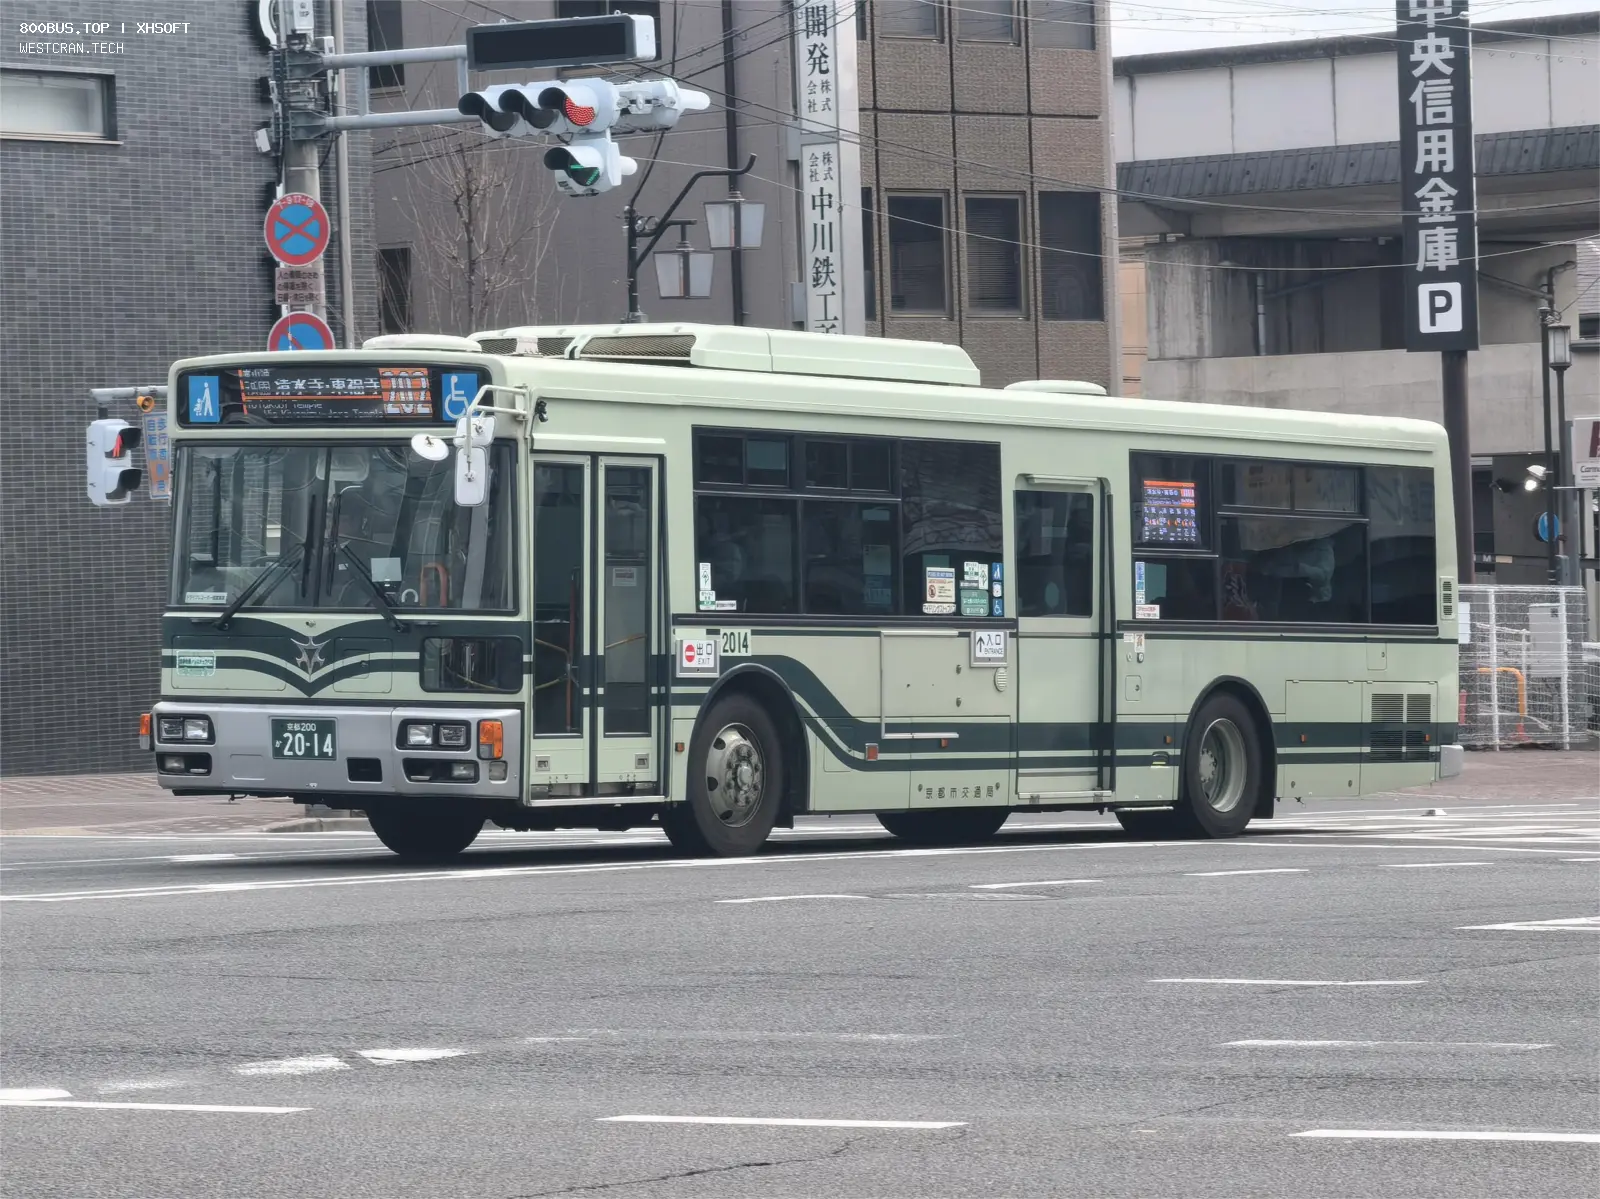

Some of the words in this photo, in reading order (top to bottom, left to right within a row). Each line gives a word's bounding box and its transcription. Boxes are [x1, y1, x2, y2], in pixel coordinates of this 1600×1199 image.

[805, 4, 830, 77] 開発
[1409, 0, 1460, 271] 中央信用金庫
[1429, 289, 1453, 327] P
[696, 642, 712, 656] 出口
[722, 631, 749, 653] 2014
[986, 634, 1002, 646] 入口
[984, 647, 1003, 655] ENTRANCE
[697, 657, 711, 665] EXIT
[283, 732, 333, 757] 20-14
[925, 785, 995, 800] 京都市交通局
